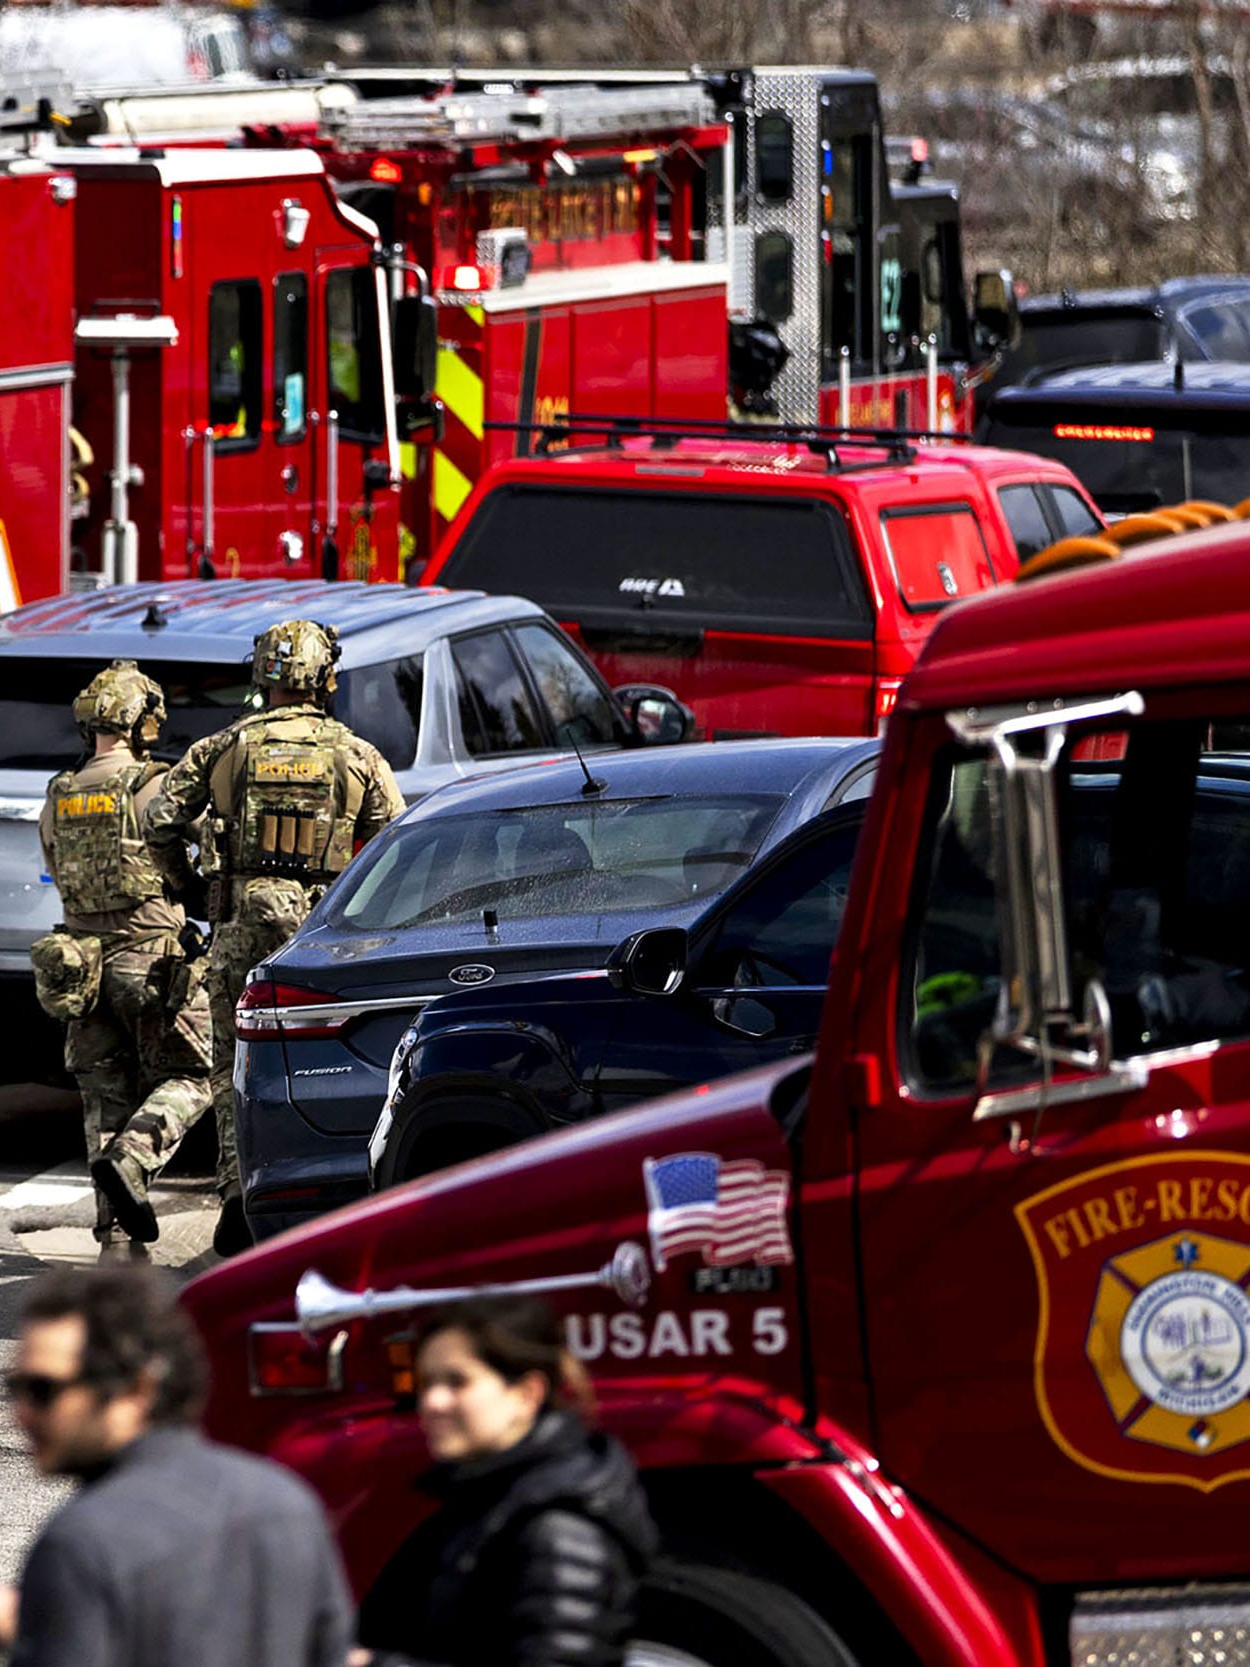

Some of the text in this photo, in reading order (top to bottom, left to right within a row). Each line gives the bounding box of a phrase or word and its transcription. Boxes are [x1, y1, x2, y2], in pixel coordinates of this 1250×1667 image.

[257, 763, 321, 778] POLICE
[58, 793, 119, 817] POLICE
[294, 1065, 353, 1076] FUSION
[564, 1306, 788, 1360] USAR 5
